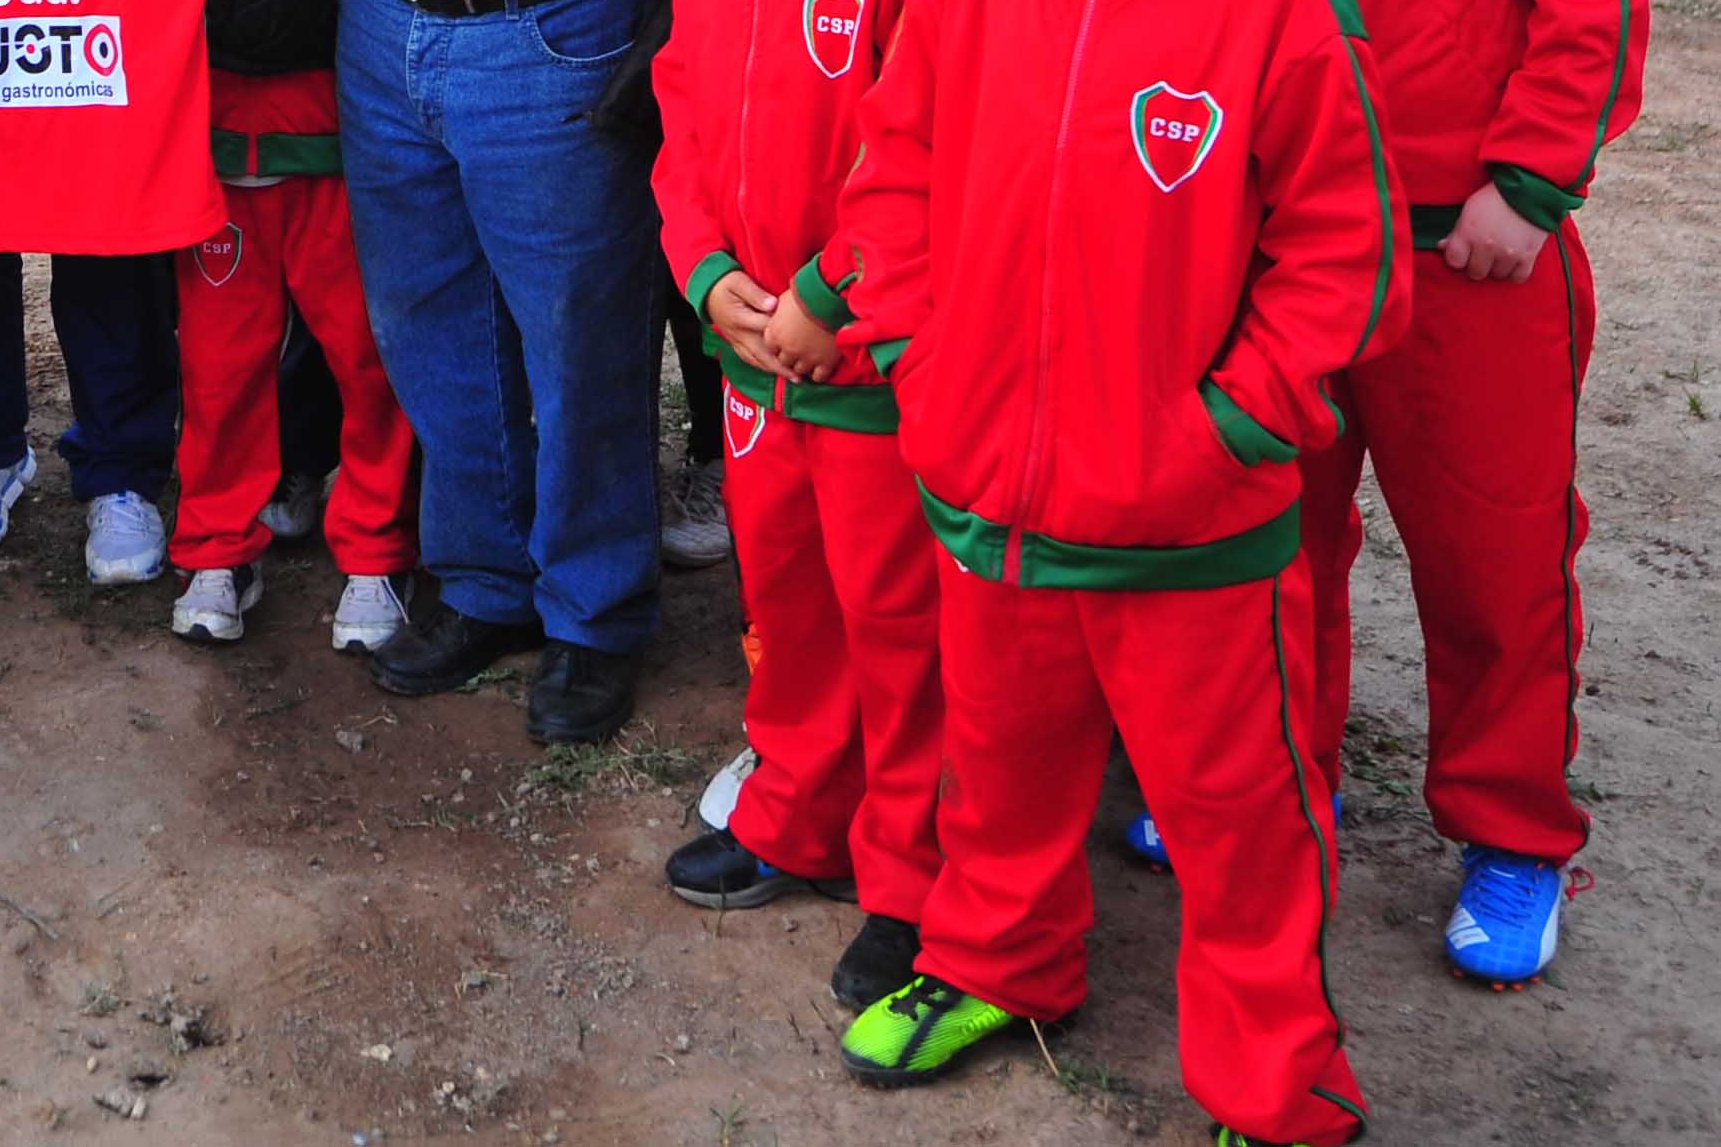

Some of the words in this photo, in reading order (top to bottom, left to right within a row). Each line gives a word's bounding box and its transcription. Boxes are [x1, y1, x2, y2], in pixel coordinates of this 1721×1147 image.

[816, 15, 855, 36] CSP
[1, 81, 114, 102] gastronómicas
[1149, 117, 1200, 143] CSP
[202, 242, 231, 254] CSP
[730, 396, 754, 421] CSP
